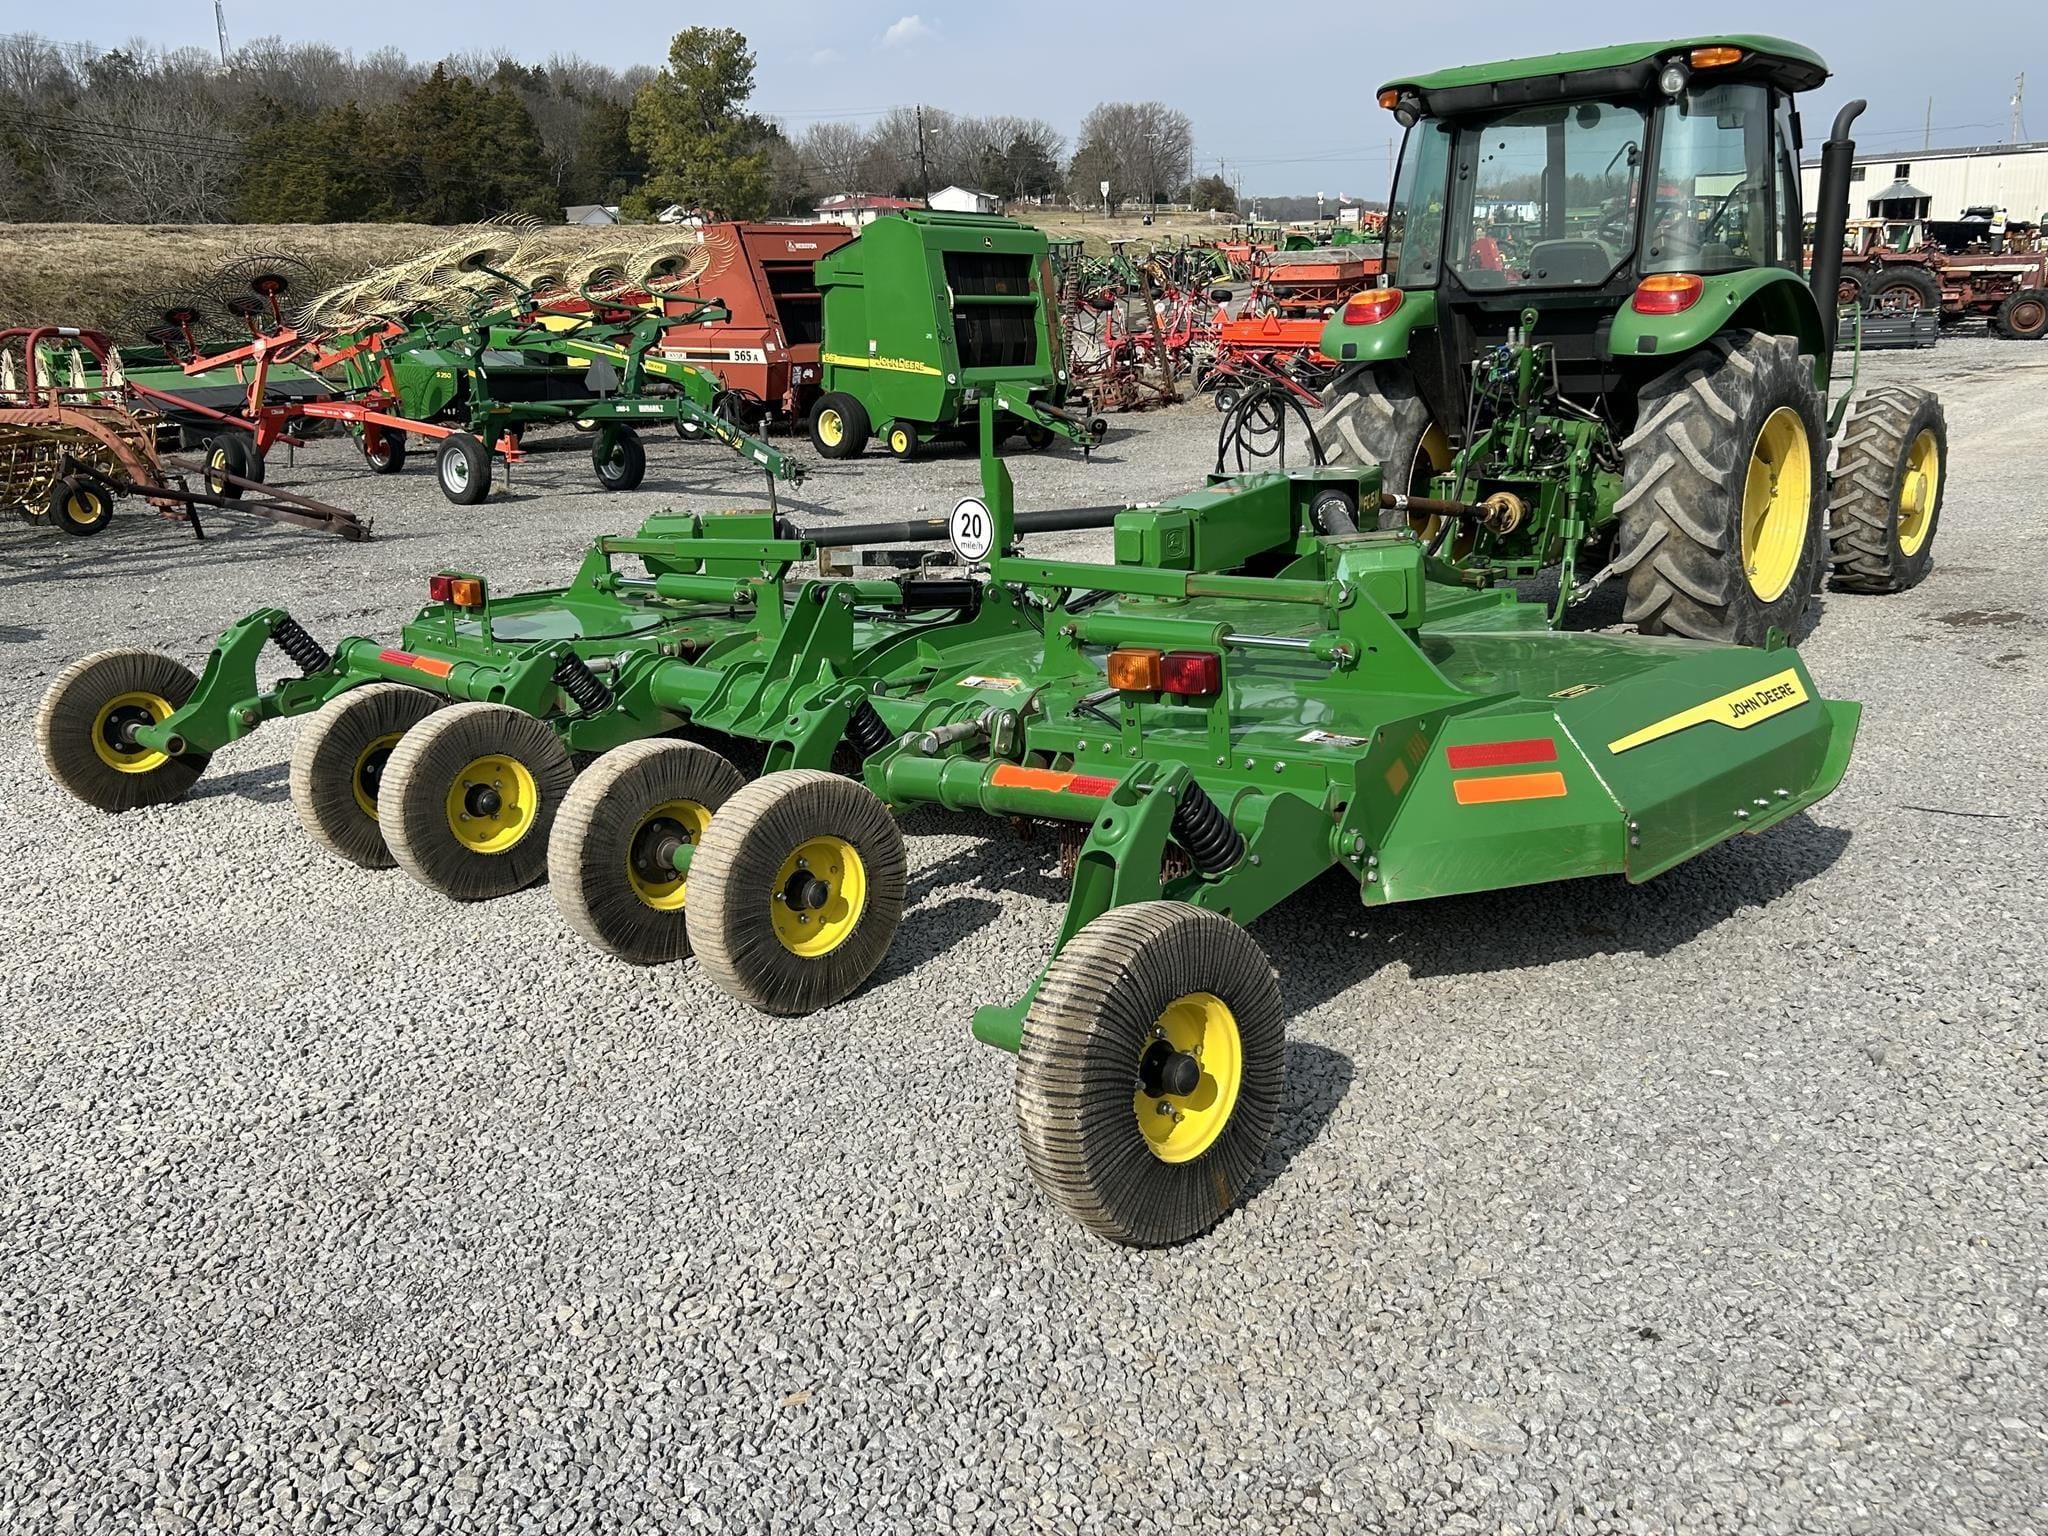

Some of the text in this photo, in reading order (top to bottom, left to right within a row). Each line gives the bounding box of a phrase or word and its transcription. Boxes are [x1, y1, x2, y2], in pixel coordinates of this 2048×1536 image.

[734, 350, 751, 361] 565
[876, 356, 925, 371] JOHN DEERE
[961, 513, 982, 538] 20
[1729, 683, 1796, 718] JOHN DEERE
